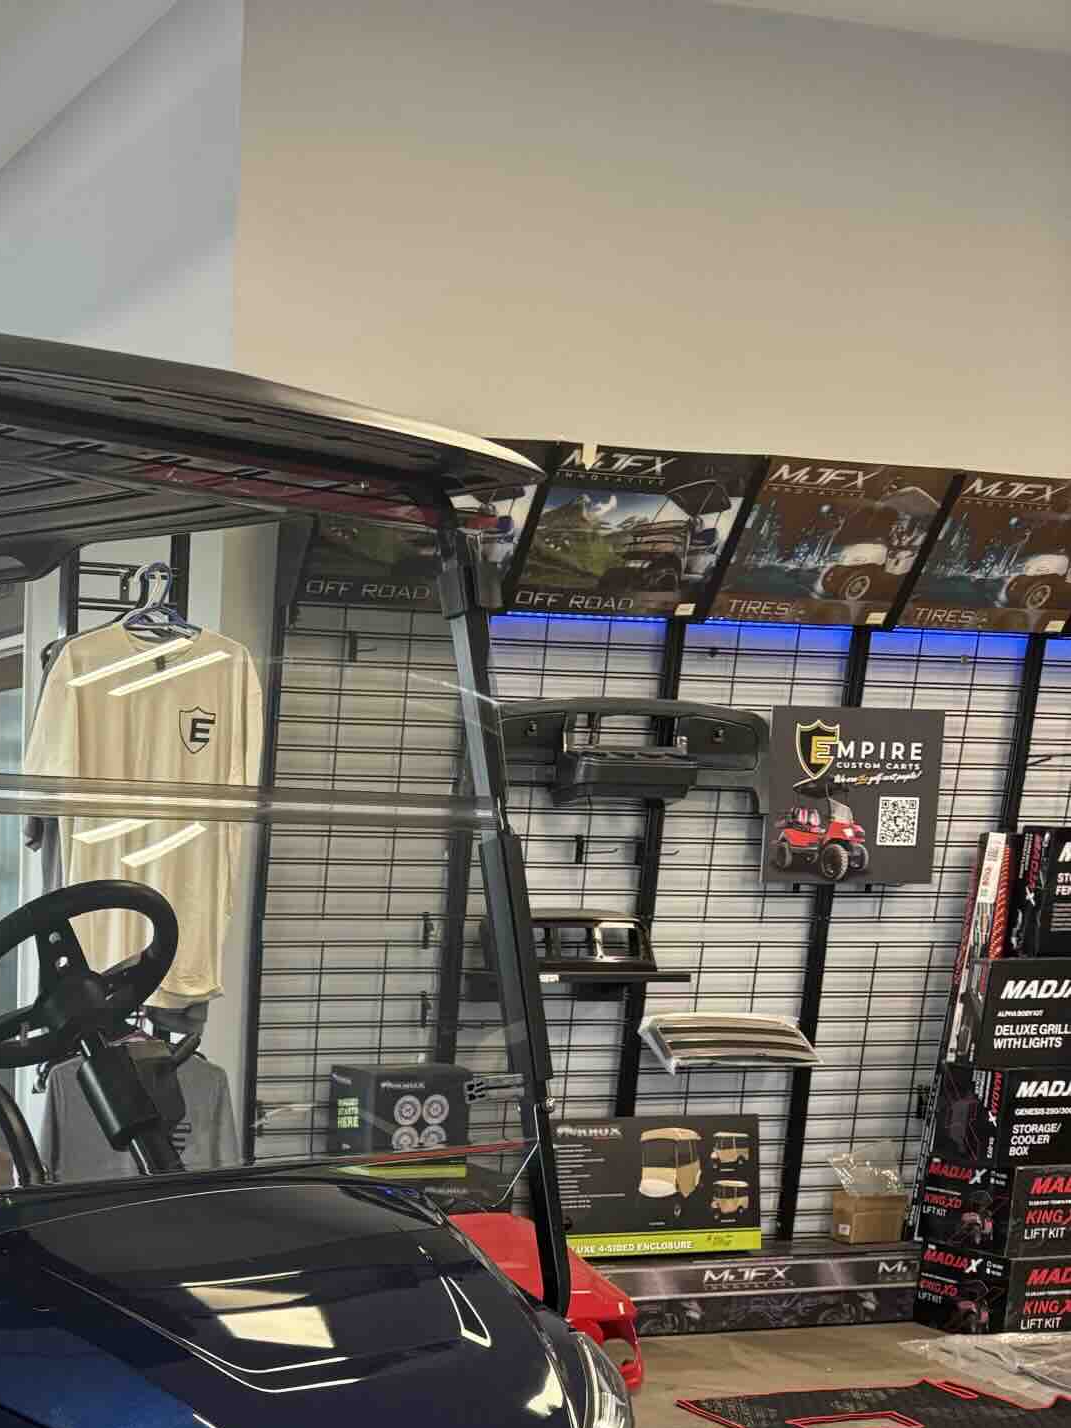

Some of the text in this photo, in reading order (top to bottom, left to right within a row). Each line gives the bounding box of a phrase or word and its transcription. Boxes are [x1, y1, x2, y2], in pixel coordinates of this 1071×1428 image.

[769, 464, 881, 489] MJFX
[961, 478, 1066, 502] MJFX
[306, 578, 431, 601] OFF ROAD
[515, 591, 633, 611] OFF ROAD
[729, 599, 790, 616] TIRES
[915, 607, 976, 624] TIRES
[885, 762, 921, 770] CARTS
[994, 1024, 1038, 1036] DELUXE
[993, 1036, 1063, 1049] WITH LIGHTS
[1011, 1134, 1050, 1145] COOLER
[1009, 1146, 1029, 1156] BOX
[923, 1206, 947, 1217] LIFT KIT
[1026, 1209, 1064, 1224] KING
[1024, 1227, 1065, 1239] LIFT KIT
[637, 1241, 694, 1251] ENCLOSURE
[923, 1249, 984, 1273] MADJAX
[704, 1266, 792, 1281] MJFX
[1024, 1301, 1058, 1314] KING
[1020, 1317, 1063, 1330] LIFT KIT
